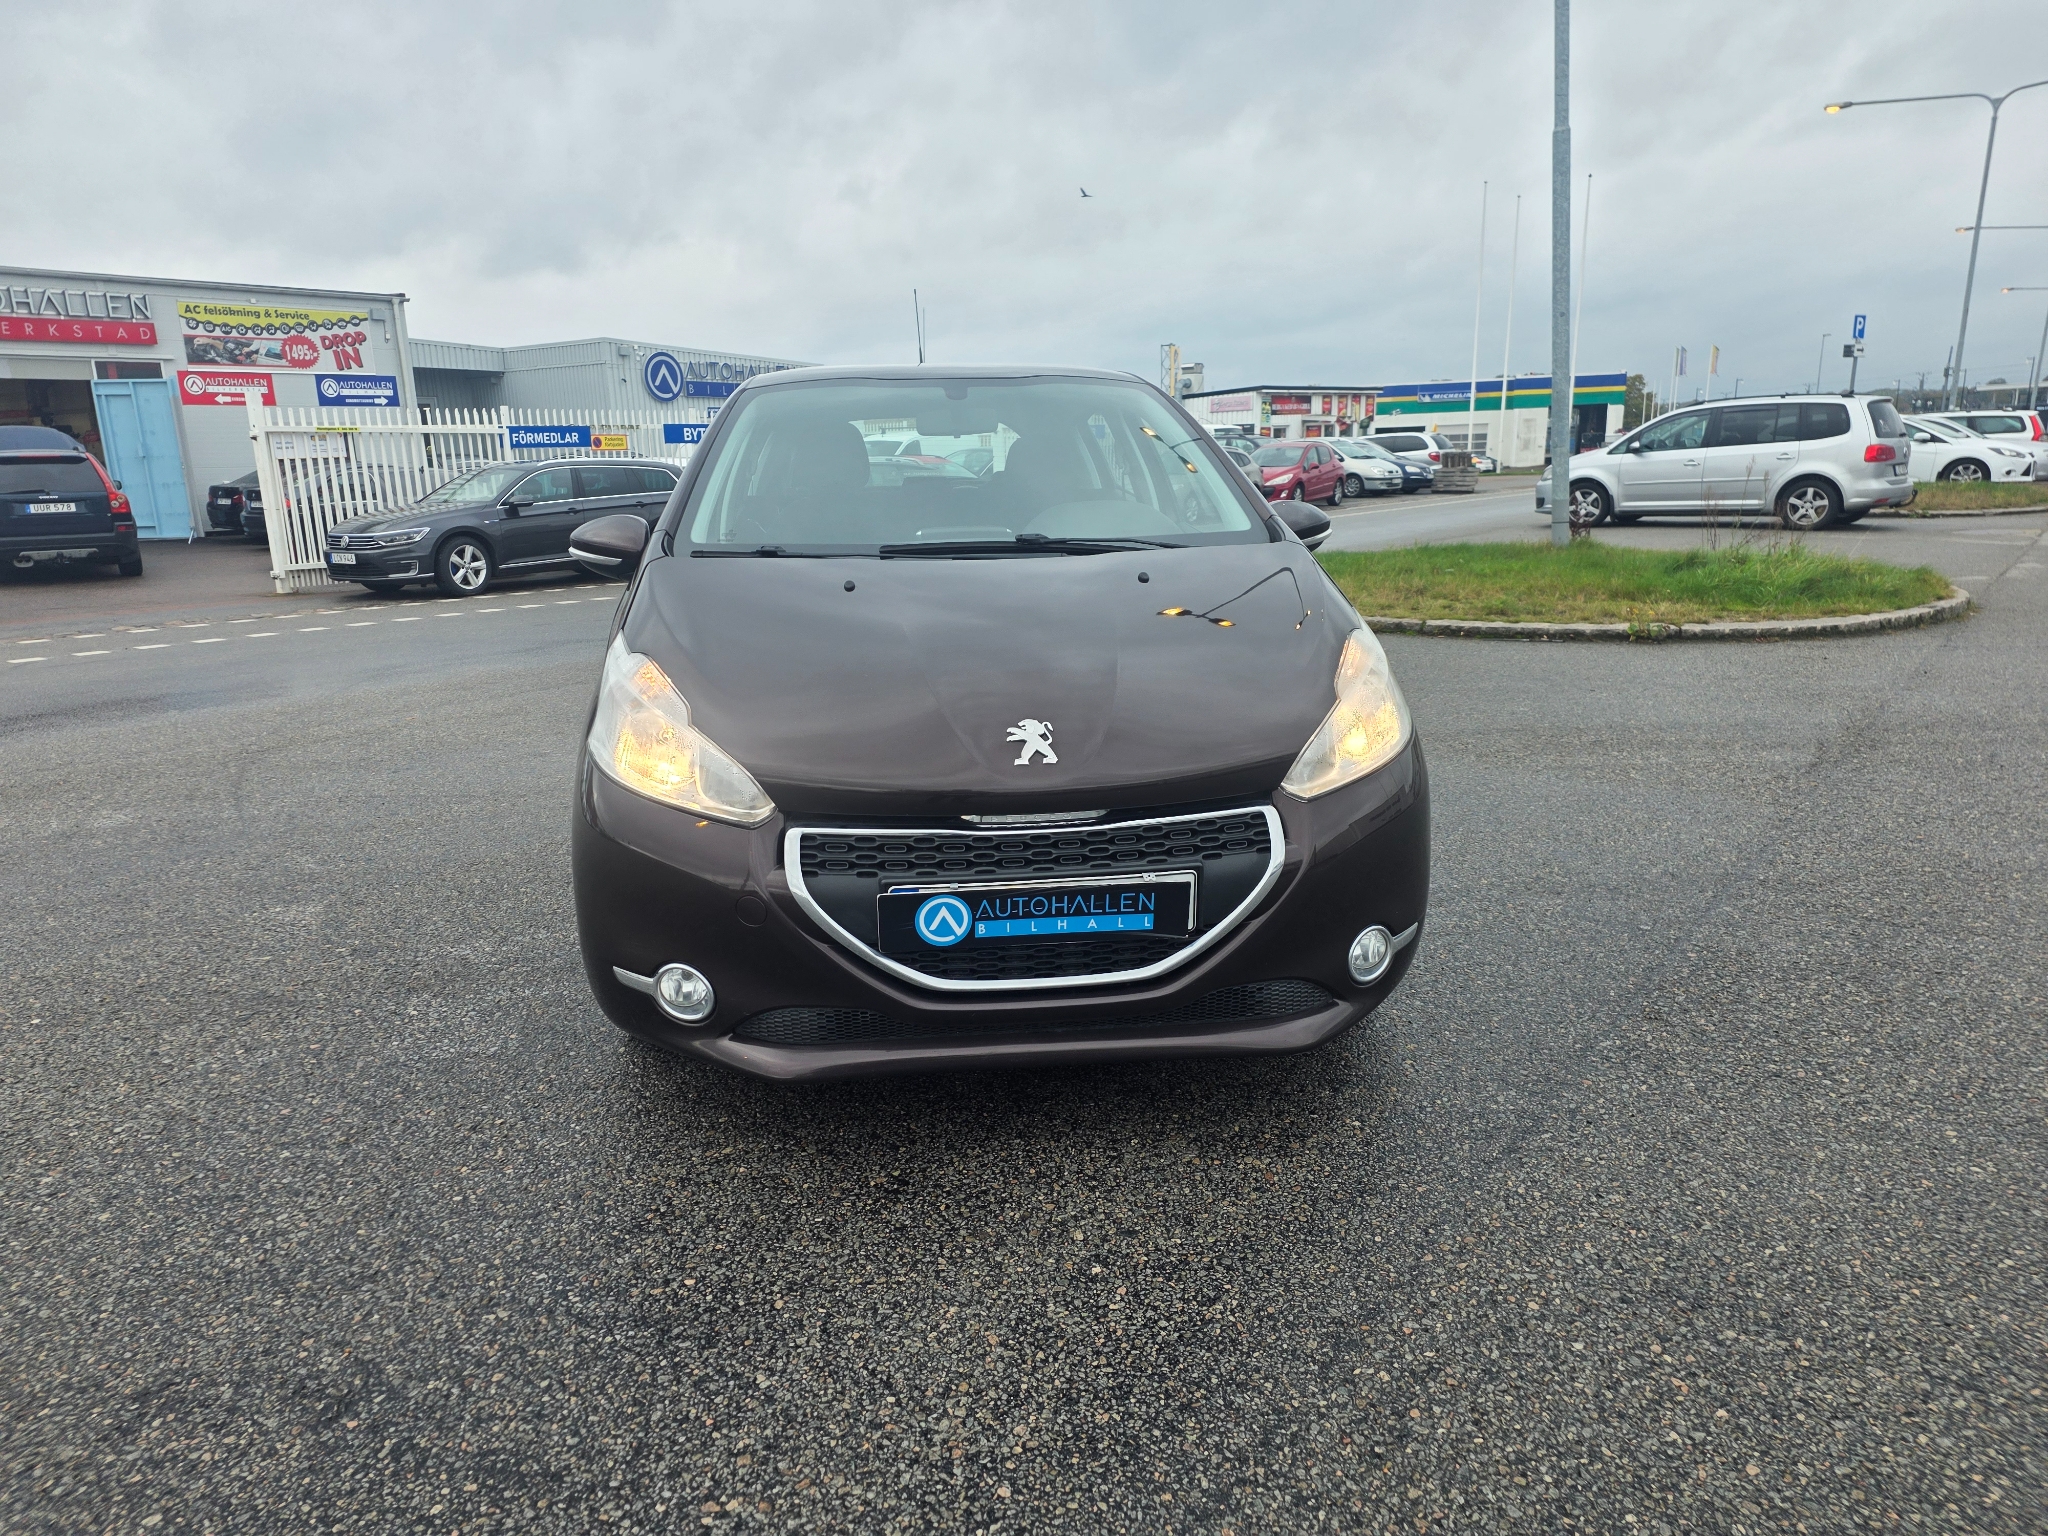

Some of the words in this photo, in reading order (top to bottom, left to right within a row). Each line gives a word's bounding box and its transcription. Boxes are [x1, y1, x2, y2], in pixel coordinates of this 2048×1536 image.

[0, 286, 152, 319] HALLEN
[184, 304, 201, 315] AC
[204, 306, 261, 319] felsökning
[264, 309, 272, 318] &
[275, 309, 310, 320] Service
[1, 321, 150, 340] ERKSTAD
[1856, 316, 1865, 338] P
[319, 331, 367, 350] DROP
[332, 347, 364, 371] IN
[205, 377, 268, 387] AUTOHALLEN
[339, 381, 393, 389] AUTOHALLEN
[688, 383, 737, 396] BIL
[512, 430, 579, 445] FÖRMEDLAR
[33, 504, 51, 512] UUR
[53, 503, 72, 511] 578
[976, 892, 1155, 919] AUTOHALLEN
[978, 916, 1151, 934] BILHALL
